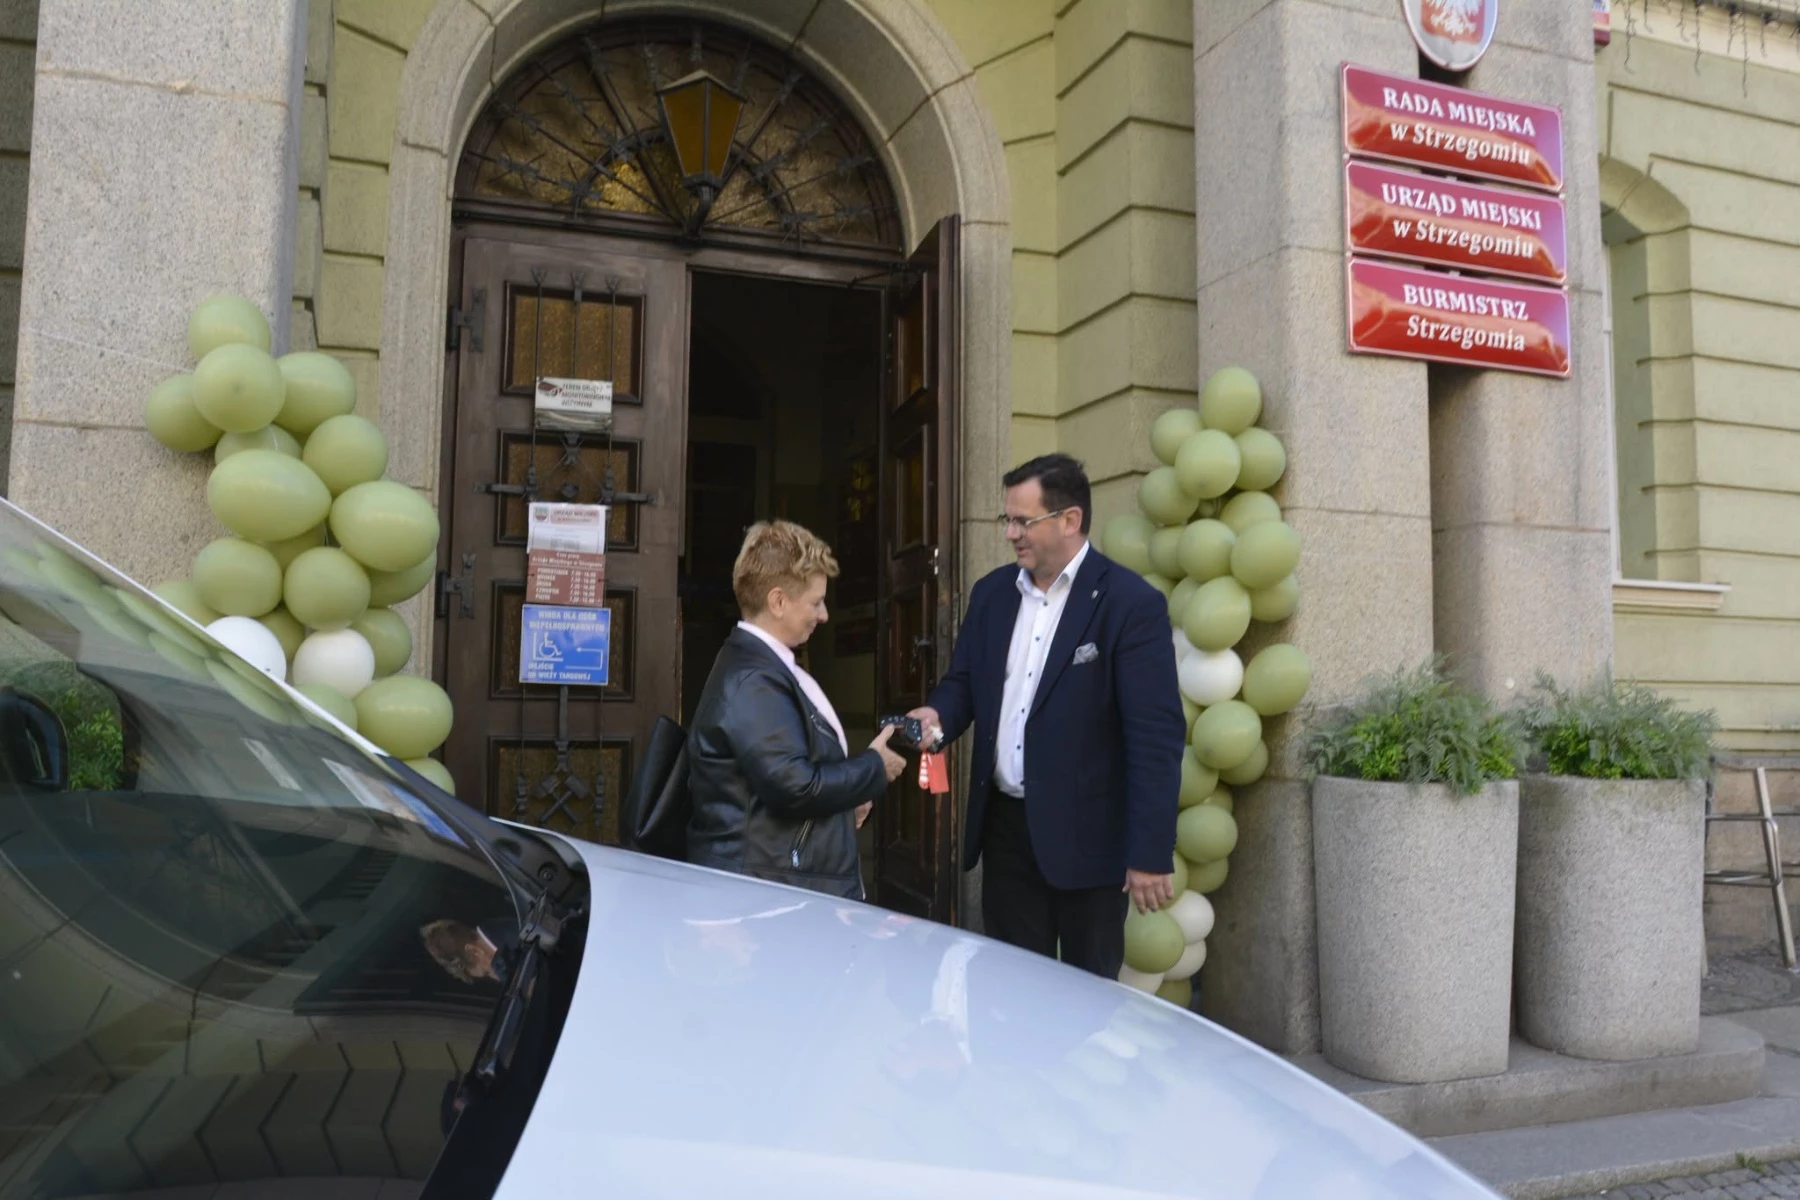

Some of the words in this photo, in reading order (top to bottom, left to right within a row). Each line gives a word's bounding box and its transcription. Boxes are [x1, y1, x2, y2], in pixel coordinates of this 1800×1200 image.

[1382, 87, 1444, 118] RADA
[1448, 101, 1536, 137] MIEJSKA
[1390, 122, 1408, 141] w
[1412, 122, 1531, 165] Strzegomiu
[1381, 183, 1457, 217] URZĄD
[1460, 197, 1542, 230] MIEJSKI
[1393, 219, 1411, 238] w
[1415, 219, 1534, 258] Strzegomiu
[1402, 283, 1529, 321] BURMISTRZ
[1406, 315, 1526, 352] Strzegomia
[538, 611, 561, 619] WINDA
[563, 611, 577, 620] DLA
